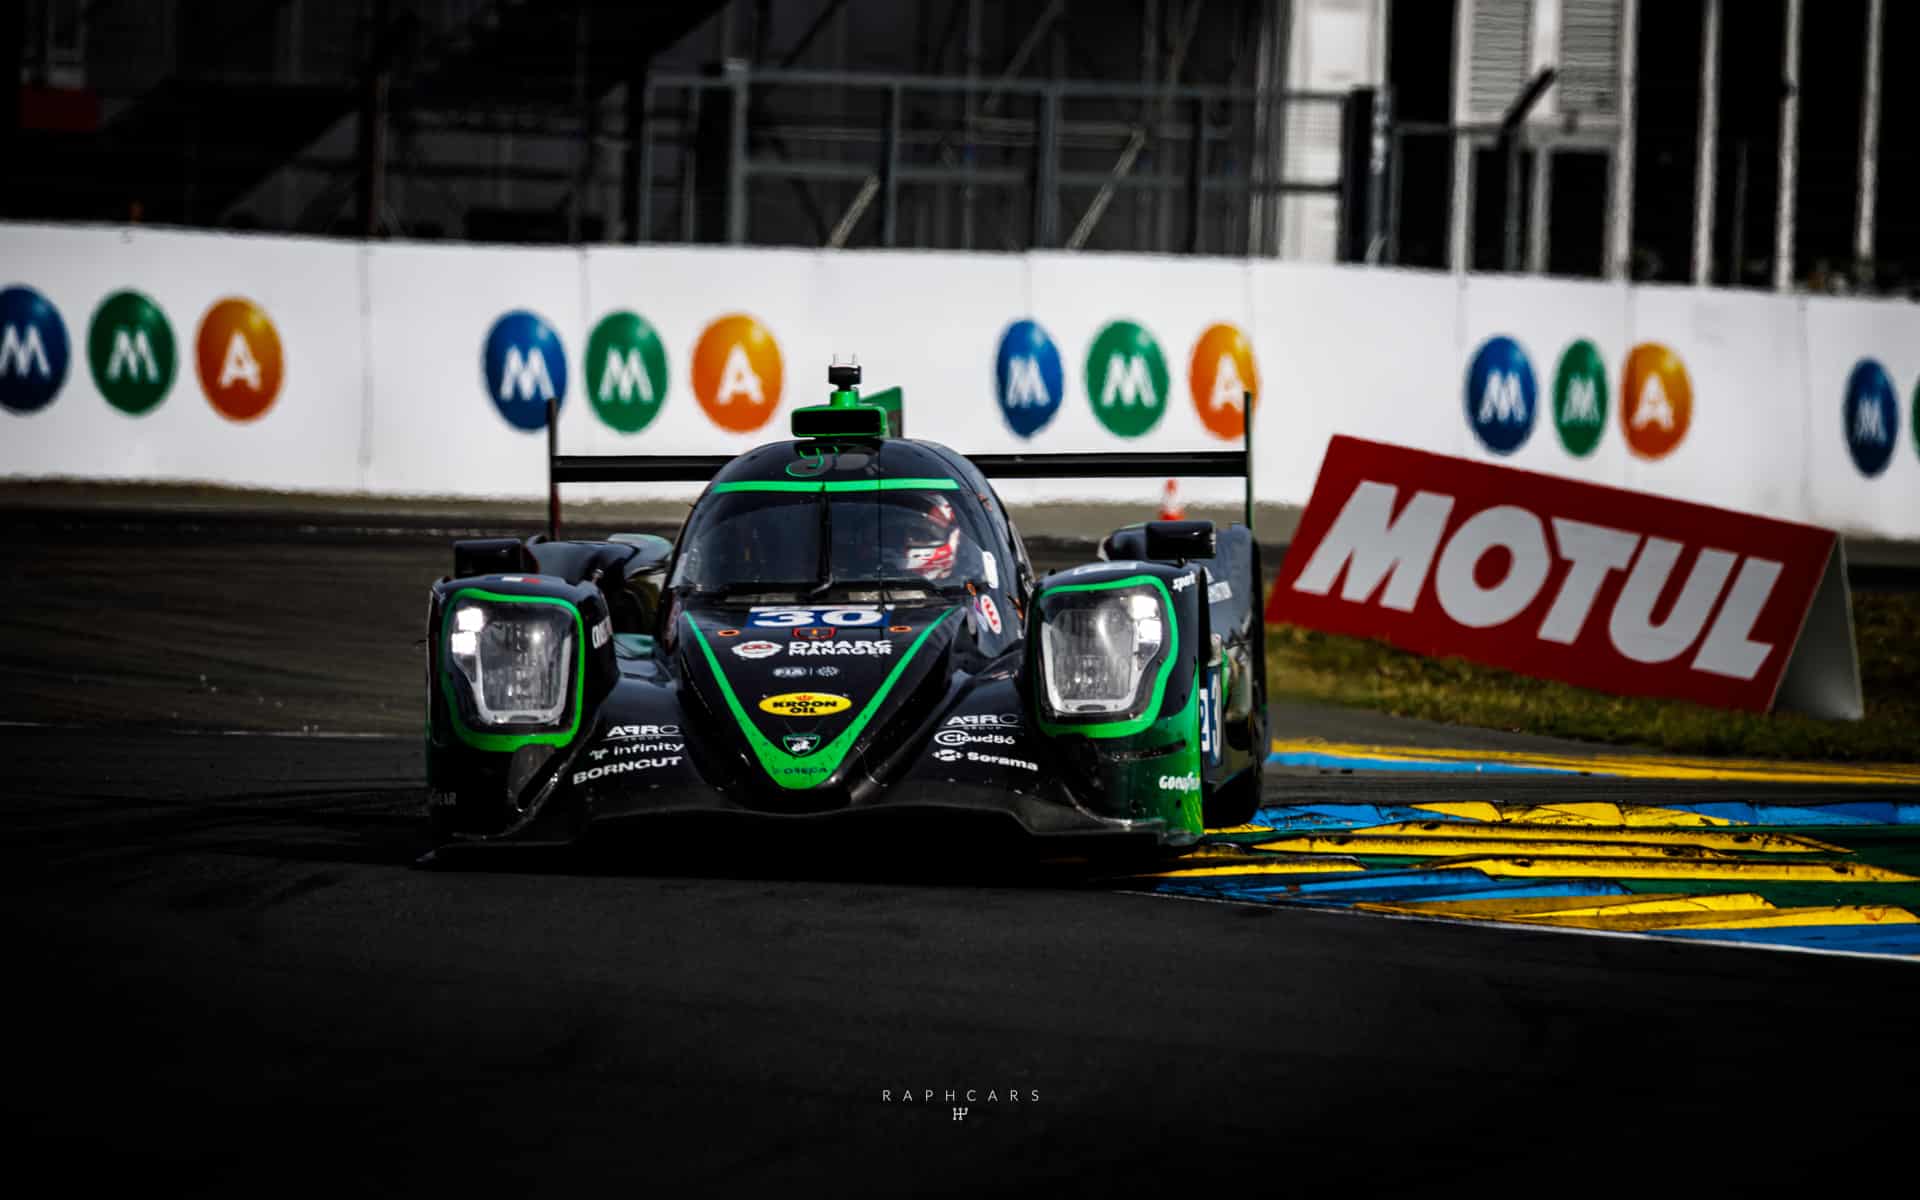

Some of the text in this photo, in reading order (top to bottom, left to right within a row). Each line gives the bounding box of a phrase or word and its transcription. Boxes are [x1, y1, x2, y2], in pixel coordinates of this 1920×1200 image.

[1291, 479, 1785, 682] MOTUL
[753, 609, 883, 627] 30
[788, 639, 894, 649] DMARC
[788, 648, 894, 658] MANAGER
[772, 700, 837, 708] KROON
[789, 707, 817, 715] OIL
[935, 730, 1016, 745] Cloud86
[613, 742, 685, 756] infinity
[966, 751, 1040, 772] Sorama
[572, 755, 684, 785] BORNCUT
